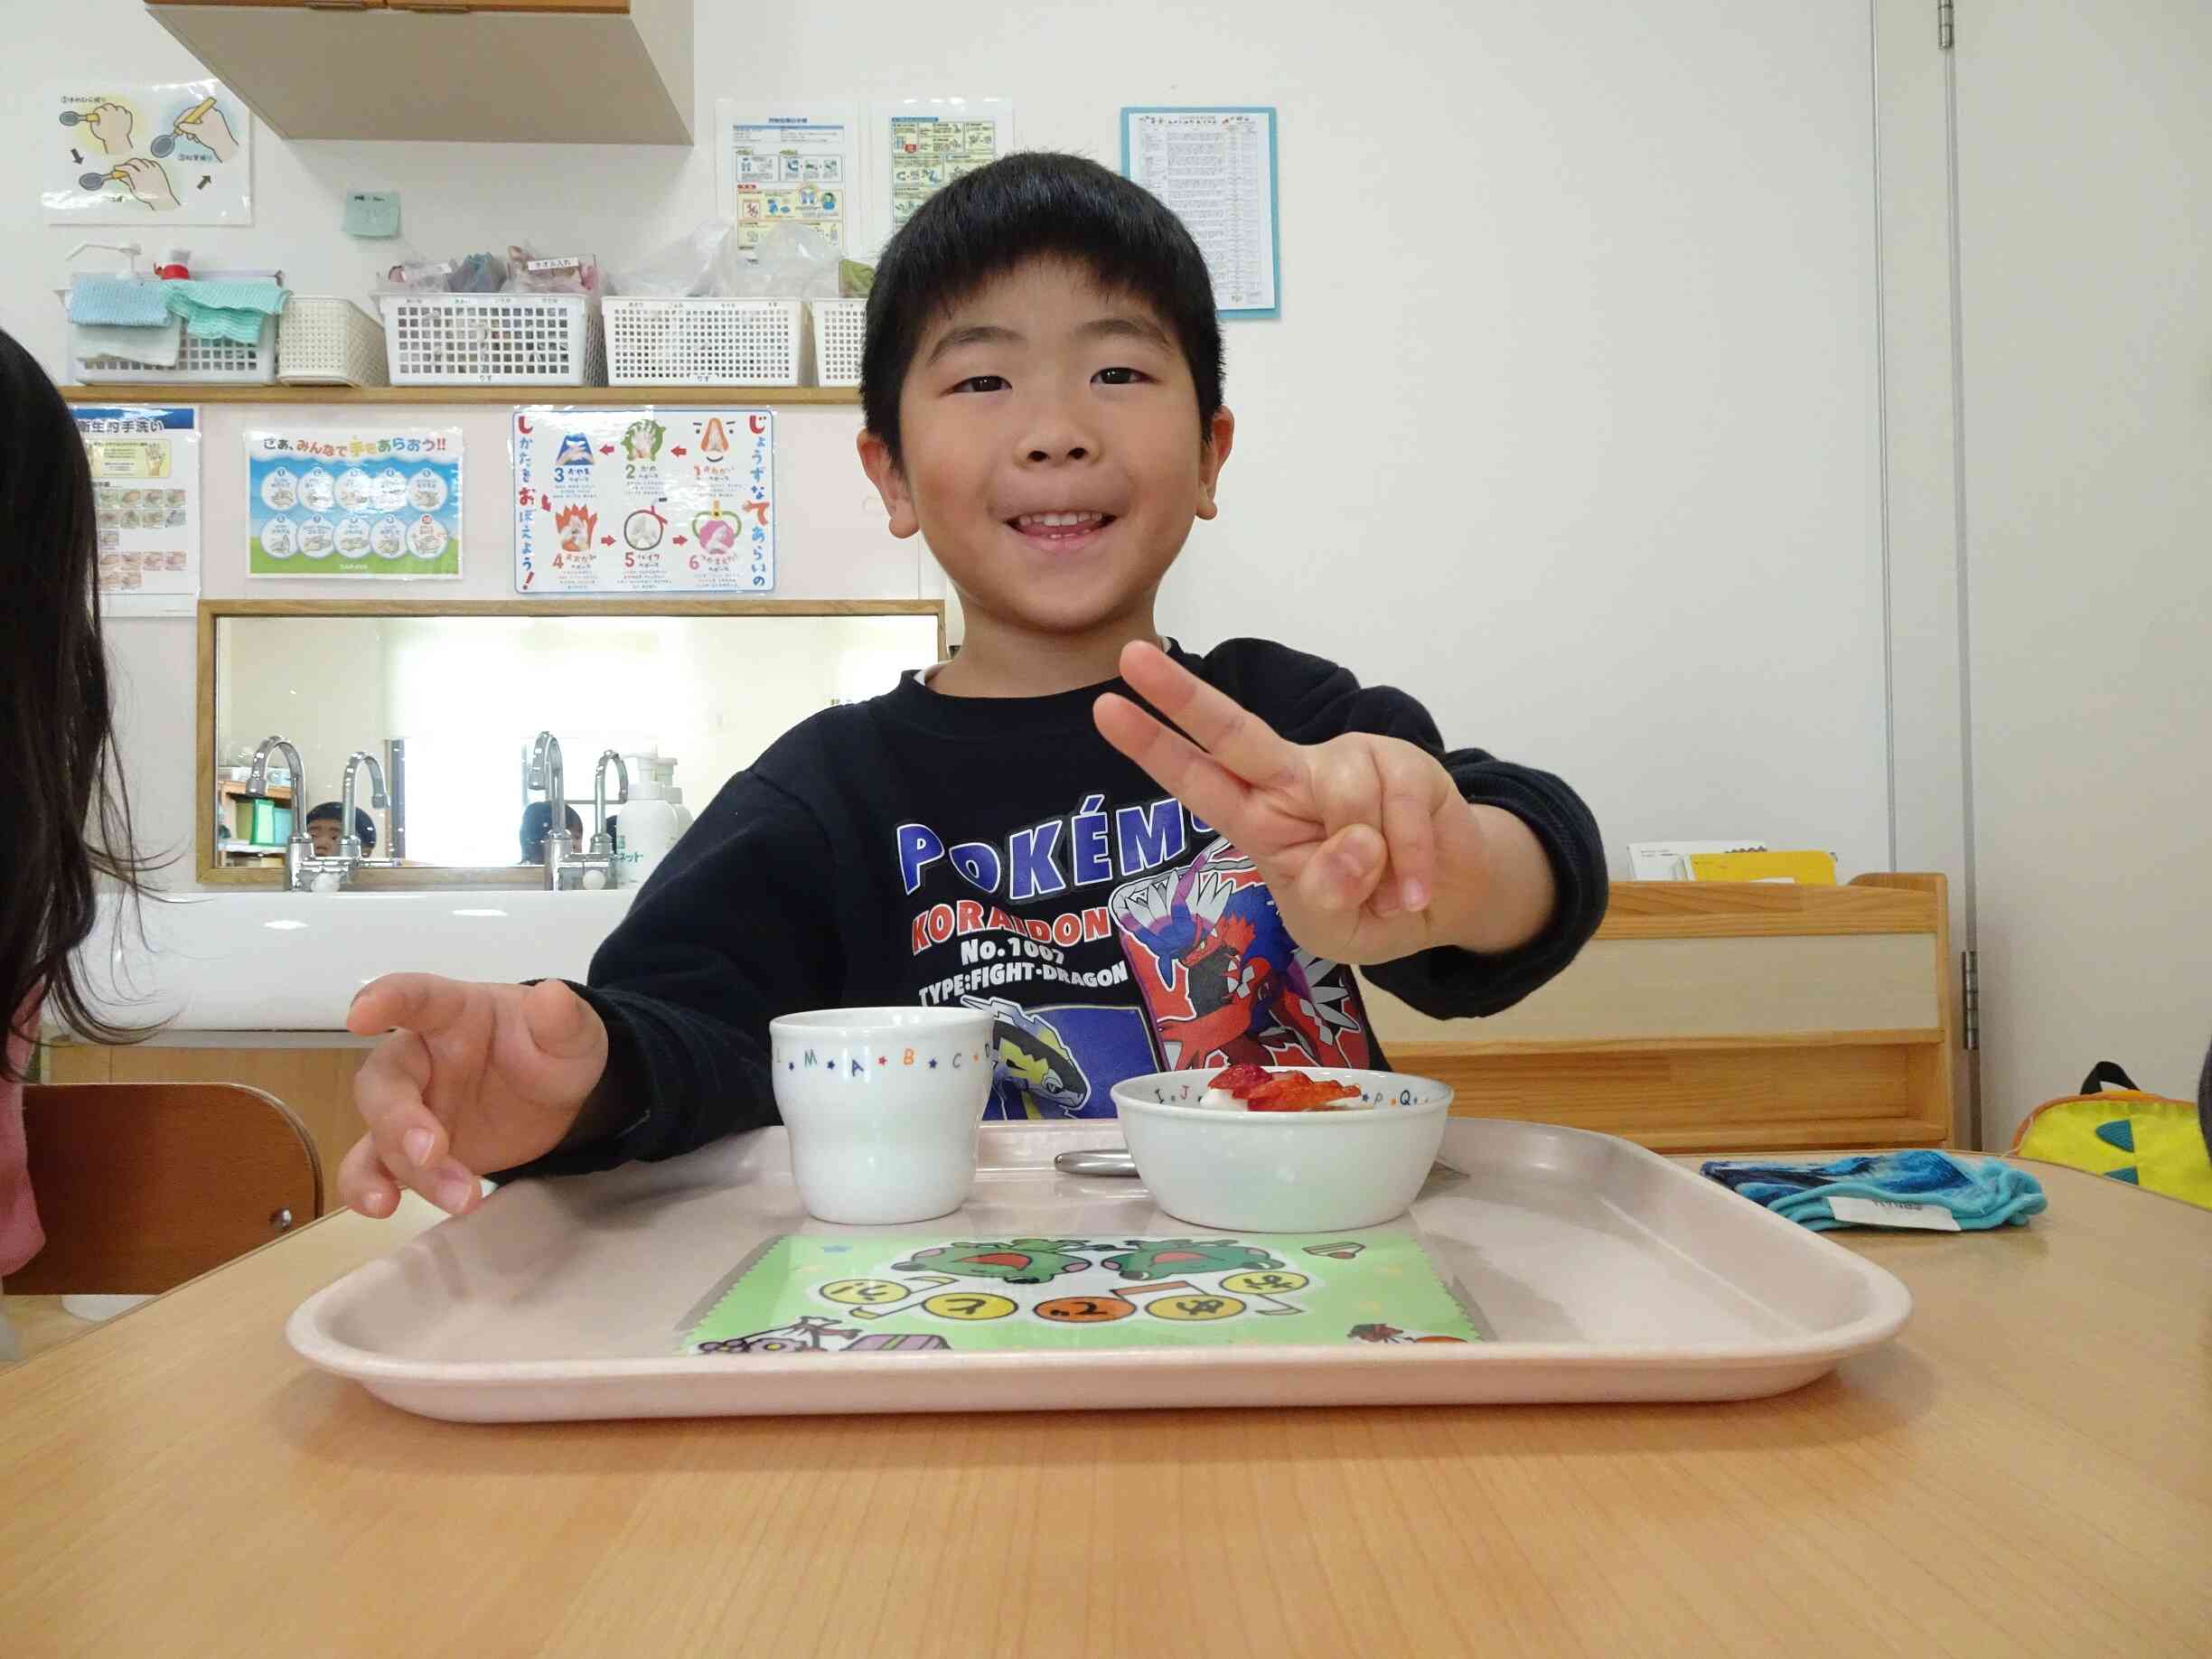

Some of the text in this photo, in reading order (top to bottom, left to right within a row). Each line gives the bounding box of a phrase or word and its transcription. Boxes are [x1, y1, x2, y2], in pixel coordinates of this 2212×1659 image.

[553, 466, 566, 483] 3
[624, 464, 636, 480] 2
[552, 554, 565, 569] 4
[624, 551, 635, 567] 5
[689, 554, 700, 570] 6
[896, 793, 1214, 900] POKÉM
[913, 900, 1112, 955] KORAIDON
[803, 1049, 819, 1067] M
[850, 1059, 866, 1077] A
[902, 1047, 915, 1066] B
[951, 1052, 963, 1069] C
[1179, 1084, 1192, 1101] J
[1399, 1089, 1412, 1107] Q
